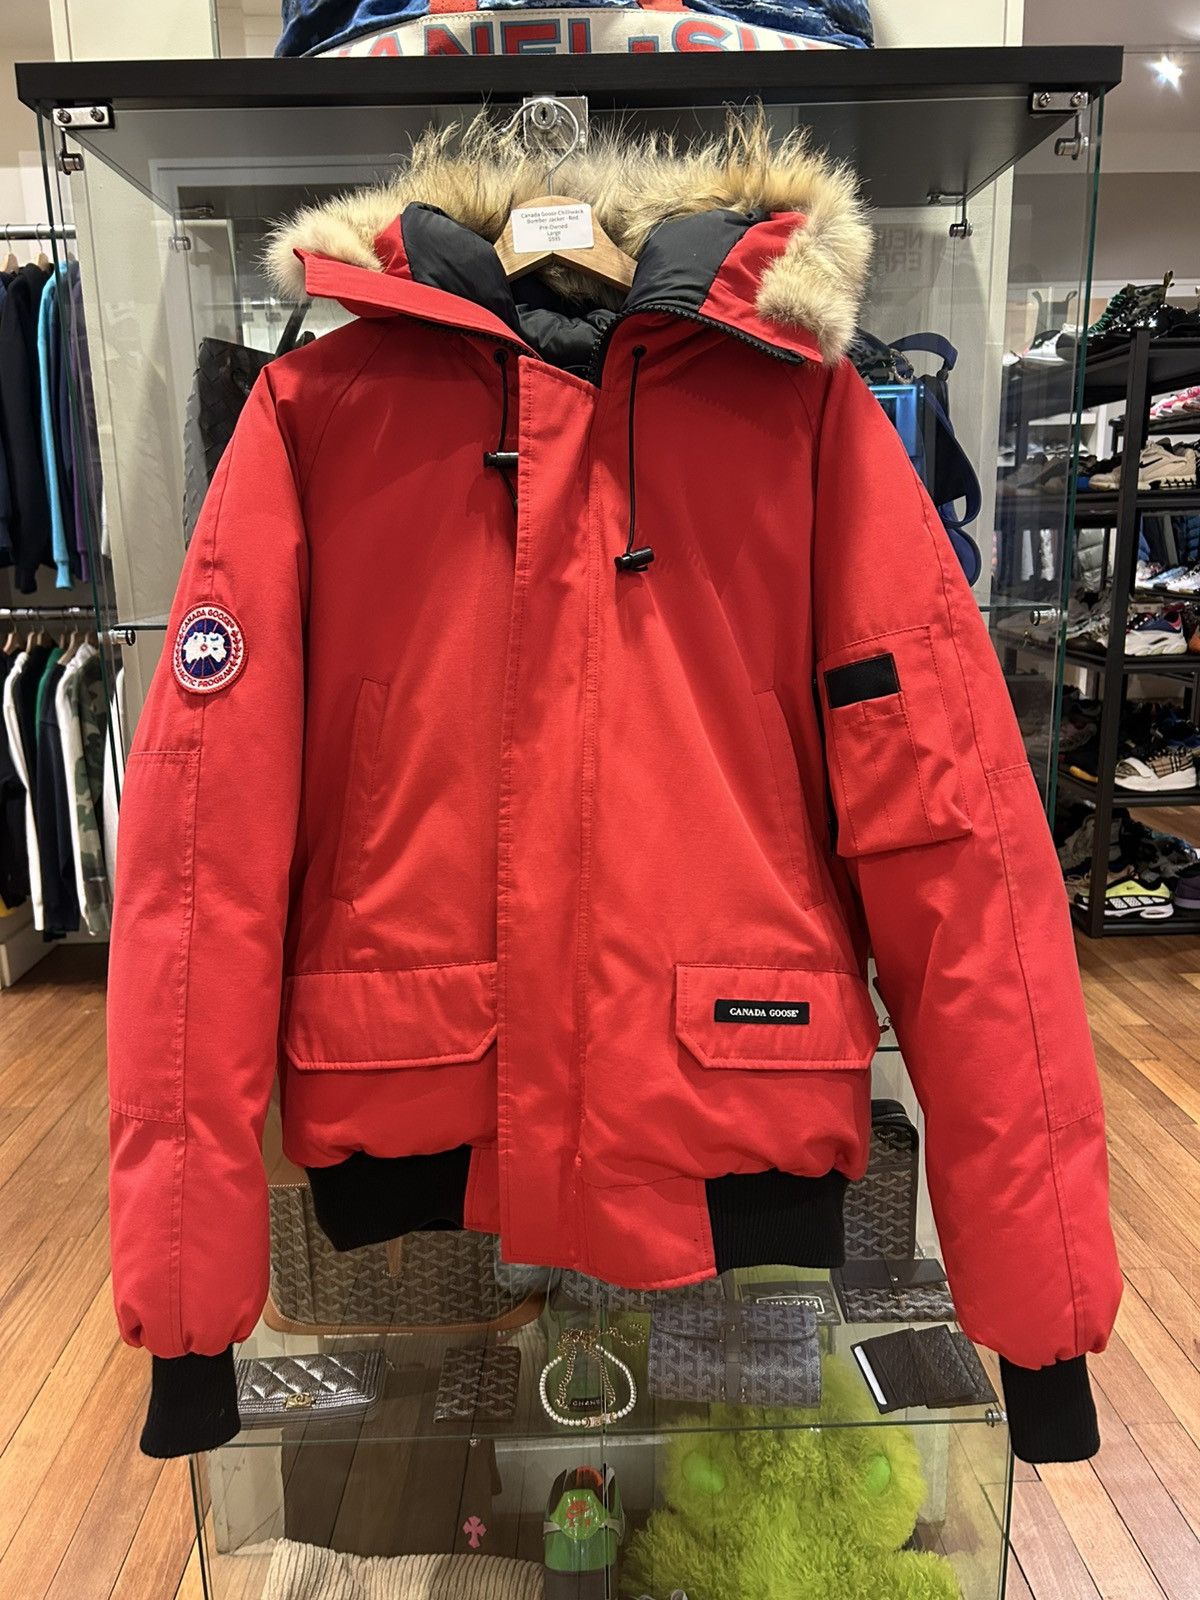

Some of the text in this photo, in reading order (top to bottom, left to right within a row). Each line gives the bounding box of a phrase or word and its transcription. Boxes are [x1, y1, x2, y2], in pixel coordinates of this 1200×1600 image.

[182, 609, 207, 632] CANADA
[197, 666, 234, 688] PROGRAM
[729, 1007, 767, 1017] CANADA
